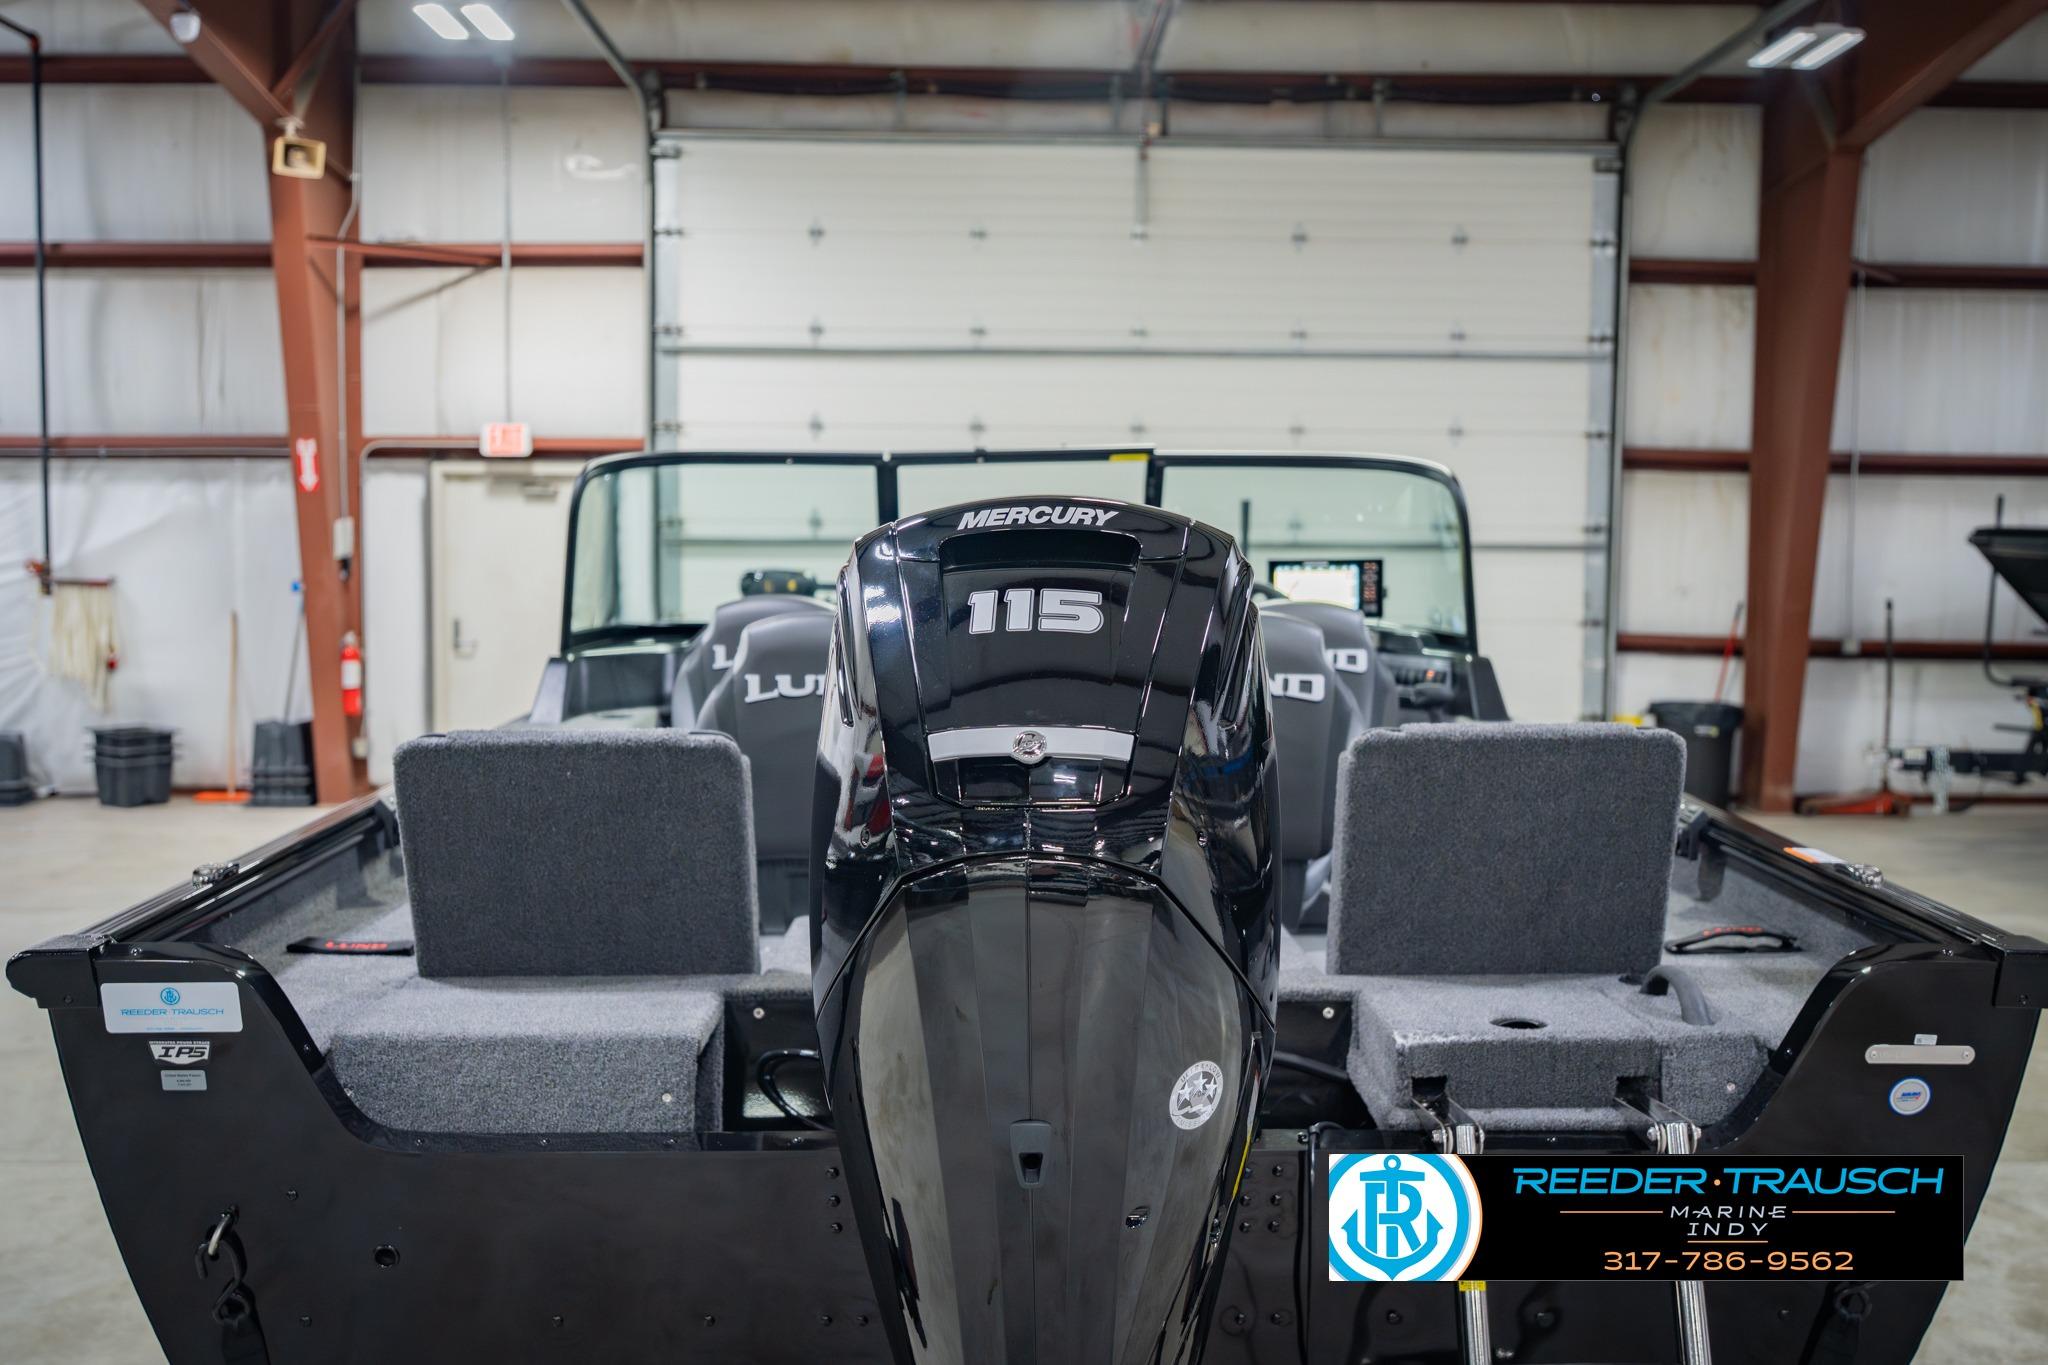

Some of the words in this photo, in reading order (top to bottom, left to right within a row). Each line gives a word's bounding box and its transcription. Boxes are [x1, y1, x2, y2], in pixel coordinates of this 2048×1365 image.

[957, 505, 1119, 531] MERCURY
[967, 588, 1104, 635] 115
[744, 673, 826, 703] LU
[120, 1008, 167, 1016] REEDER
[172, 1007, 224, 1016] TRAUSCH
